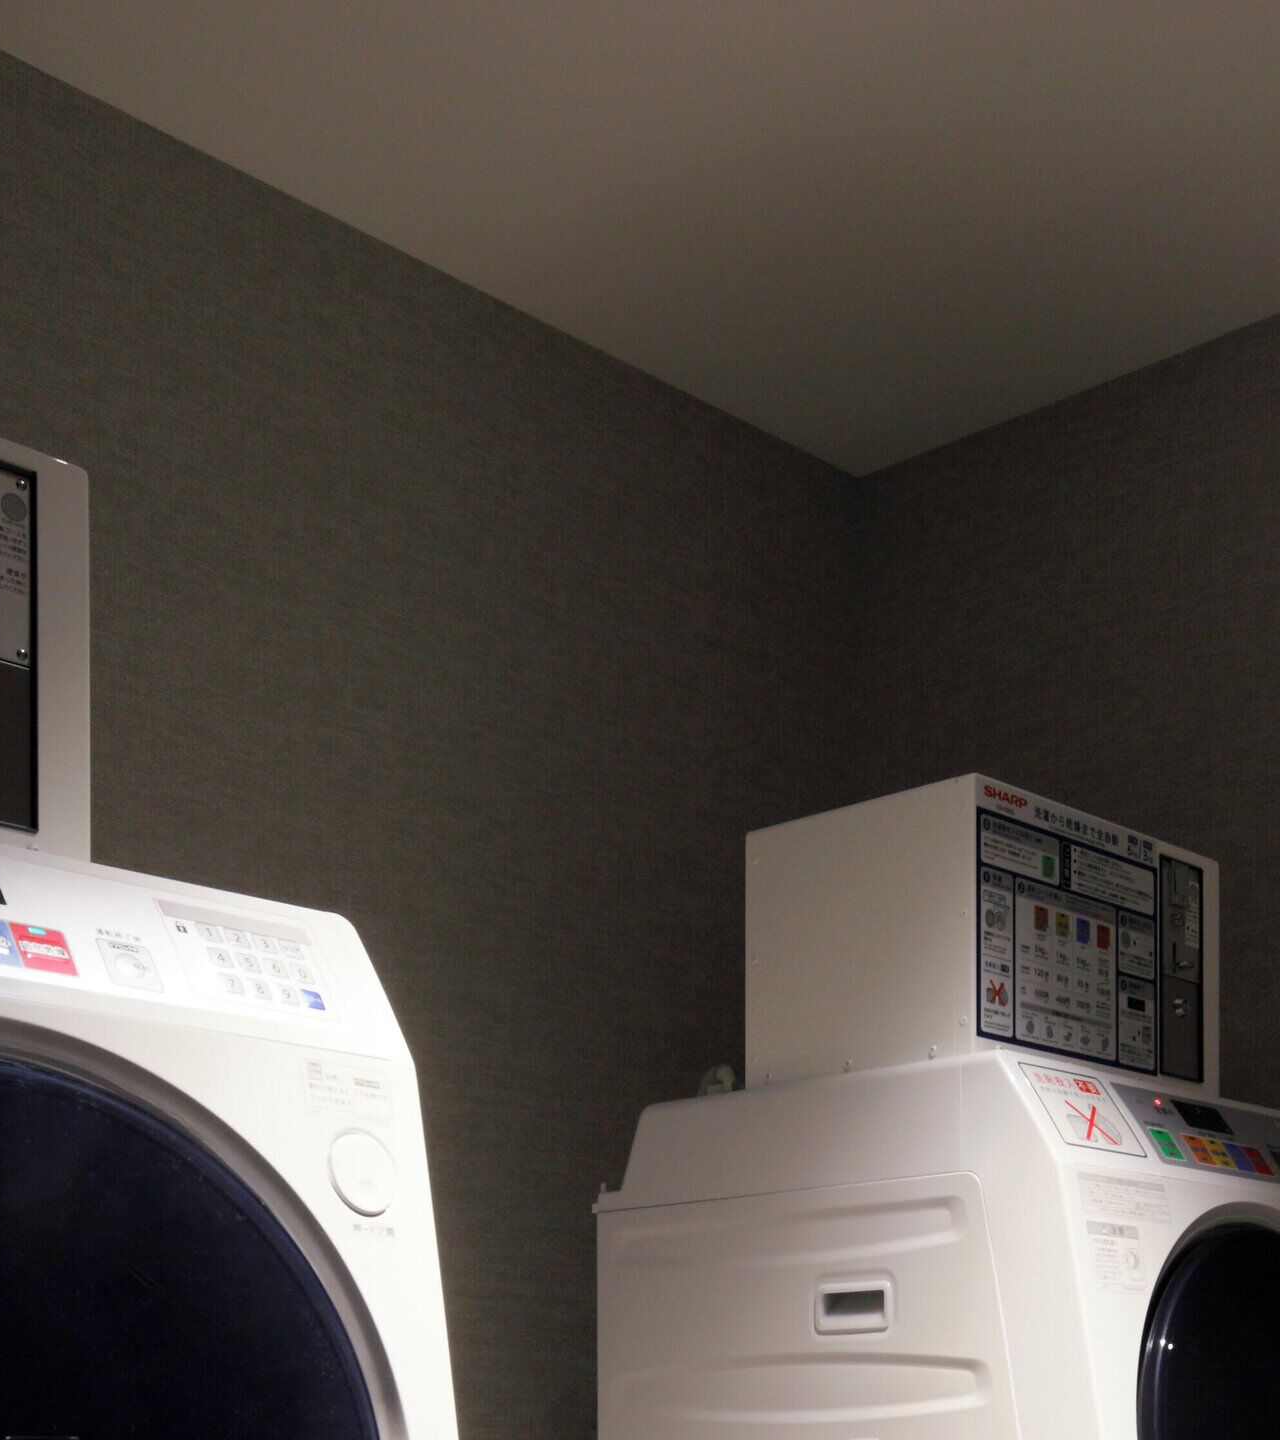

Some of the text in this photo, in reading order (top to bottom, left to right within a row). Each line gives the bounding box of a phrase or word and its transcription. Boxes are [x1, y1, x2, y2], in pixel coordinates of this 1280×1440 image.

[984, 783, 1027, 810] SHARP
[233, 932, 243, 944] 2
[260, 938, 270, 949] 3
[217, 952, 225, 963] 4
[244, 958, 254, 968] 5
[272, 964, 282, 974] 6
[226, 978, 291, 1000] 7 8 9
